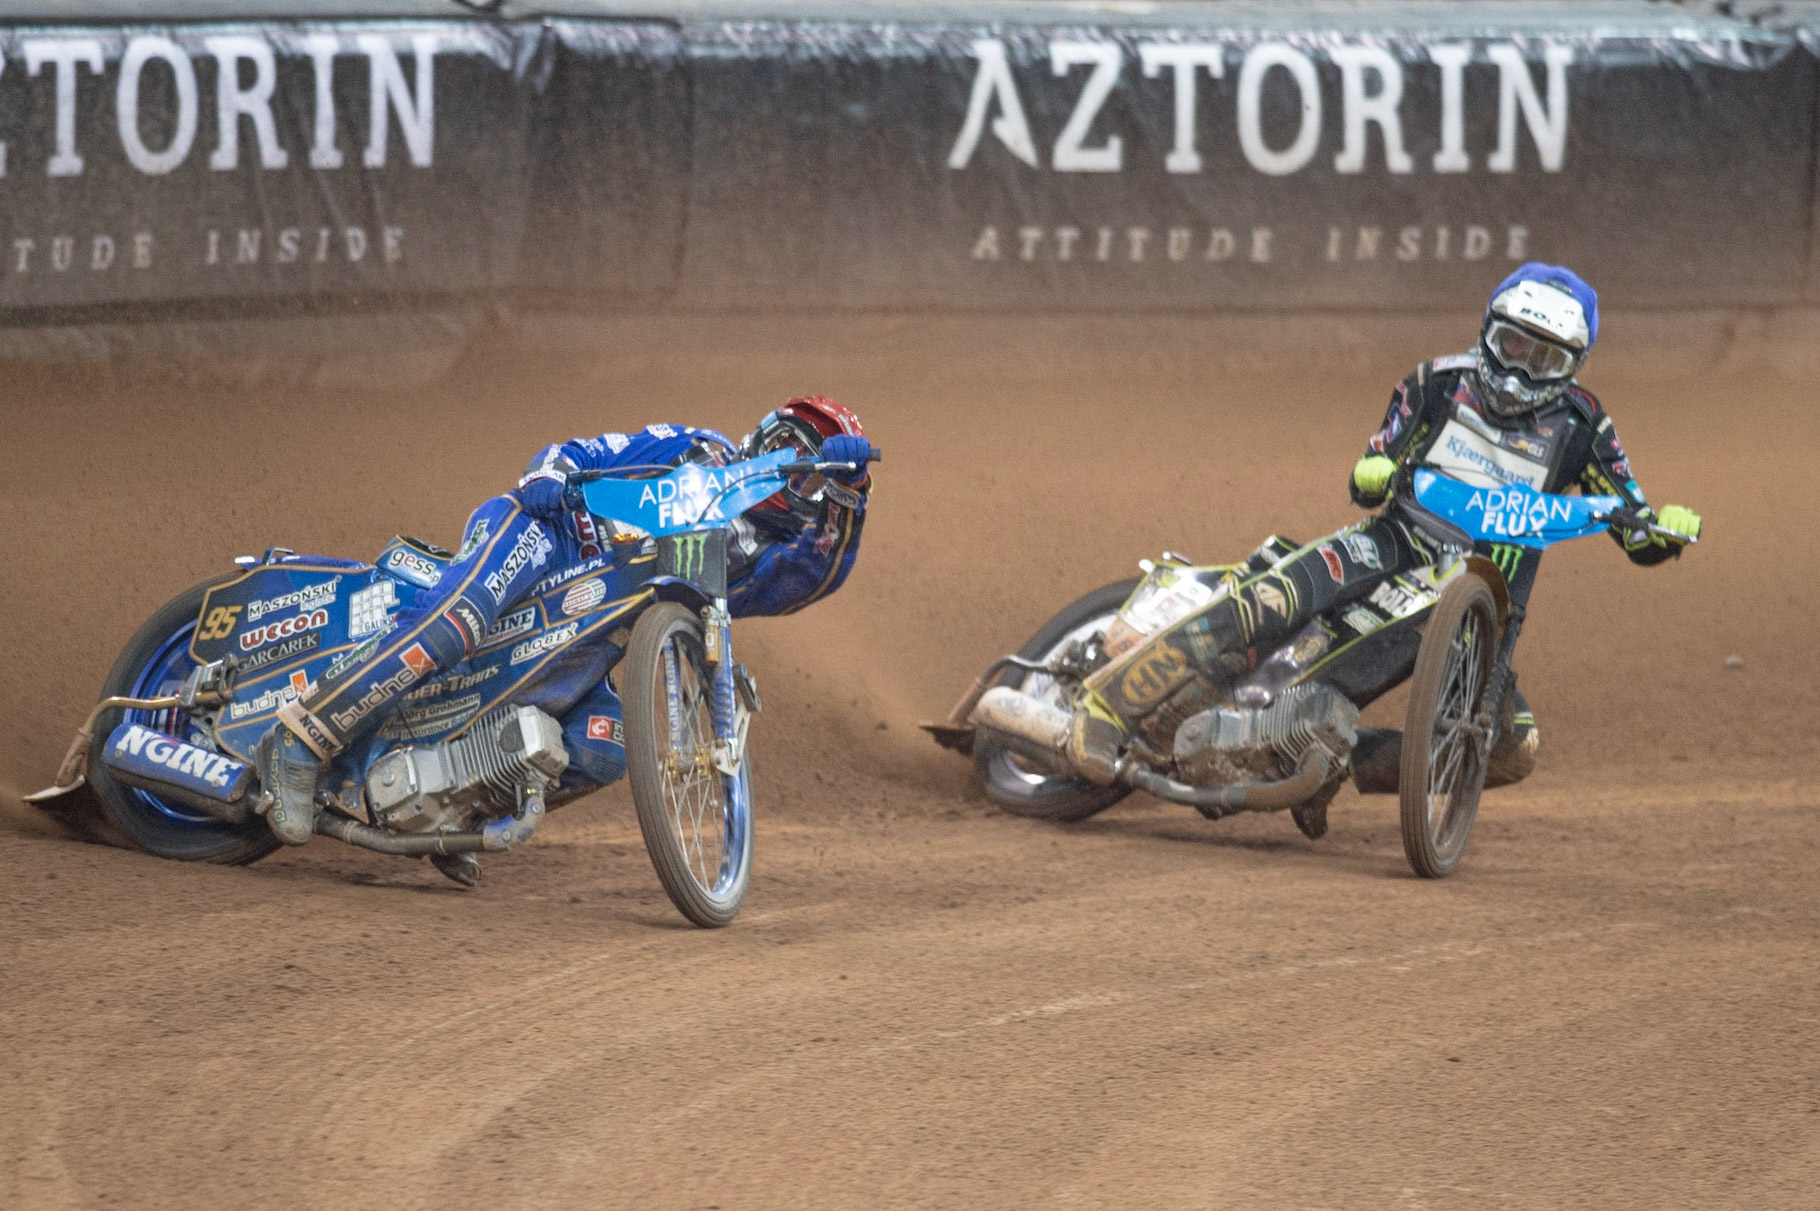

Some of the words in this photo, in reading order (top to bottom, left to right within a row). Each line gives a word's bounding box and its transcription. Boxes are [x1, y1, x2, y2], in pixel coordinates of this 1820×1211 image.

[0, 37, 437, 176] TORIN
[946, 39, 1575, 174] AZTORIN
[206, 227, 404, 265] INSIDE
[971, 225, 1275, 264] ATTITUDE
[1325, 225, 1530, 262] INSIDE
[1465, 489, 1572, 523] ADRIAN
[1481, 511, 1548, 538] FLUX
[199, 605, 243, 640] 95
[241, 610, 328, 650] wecon
[513, 623, 578, 659] GLOBEX
[116, 725, 241, 787] NGINE
